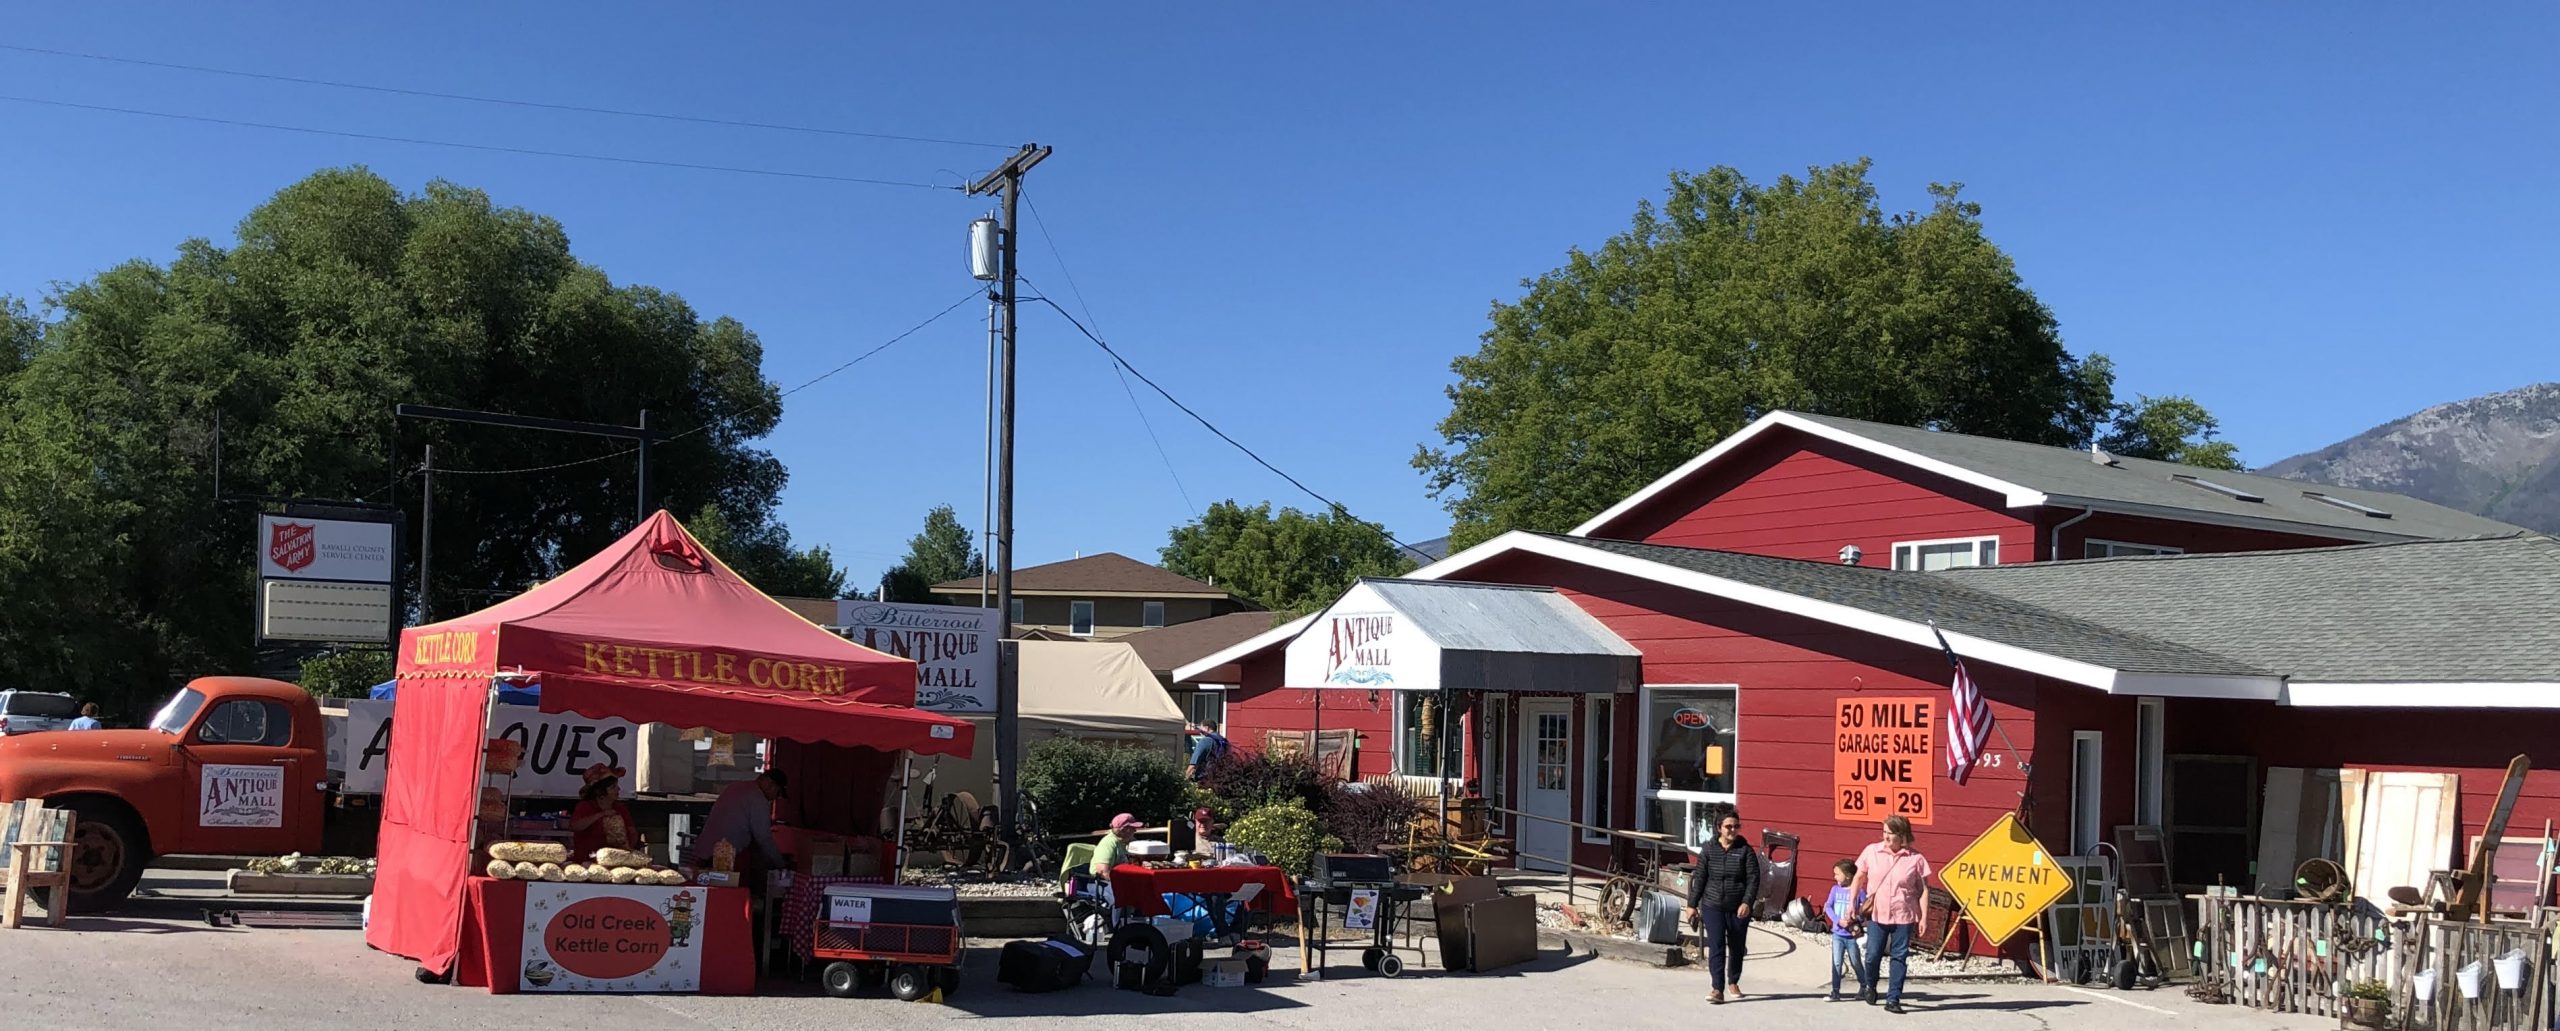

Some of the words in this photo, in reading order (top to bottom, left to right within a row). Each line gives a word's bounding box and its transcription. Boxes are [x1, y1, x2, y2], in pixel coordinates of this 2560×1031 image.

[272, 529, 312, 560] SALVATION
[280, 527, 297, 542] THE
[287, 545, 311, 567] ARMY
[321, 543, 351, 552] RAVALLI
[353, 545, 385, 553] COUNTY
[322, 551, 352, 560] SERVICE
[354, 553, 385, 561] CENTER
[852, 605, 983, 630] Bitterroot
[415, 632, 452, 665] KETTLE
[452, 631, 479, 665] CORN
[1324, 616, 1393, 683] ANTIQUE
[1355, 648, 1392, 666] MALL
[583, 642, 741, 686] KETTLE
[748, 658, 847, 696] CORN
[917, 667, 977, 688] MALL
[1675, 713, 1707, 725] OPEN
[1840, 703, 1864, 728] 50
[1871, 703, 1929, 728] MILE
[1838, 733, 1889, 754] GARAGE
[1893, 734, 1929, 754] SALE
[1851, 758, 1912, 782] JUNE
[203, 777, 278, 815] ANTIQUE
[239, 796, 276, 807] MALL
[1843, 789, 1865, 810] 28
[1897, 792, 1923, 814] 29
[1958, 862, 2051, 885] PAVEMENT
[834, 899, 866, 909] WATER
[1976, 889, 2026, 910] ENDS
[562, 913, 595, 930] Old
[601, 915, 656, 931] Creek
[555, 936, 609, 953] Kettle
[615, 938, 659, 954] Corn
